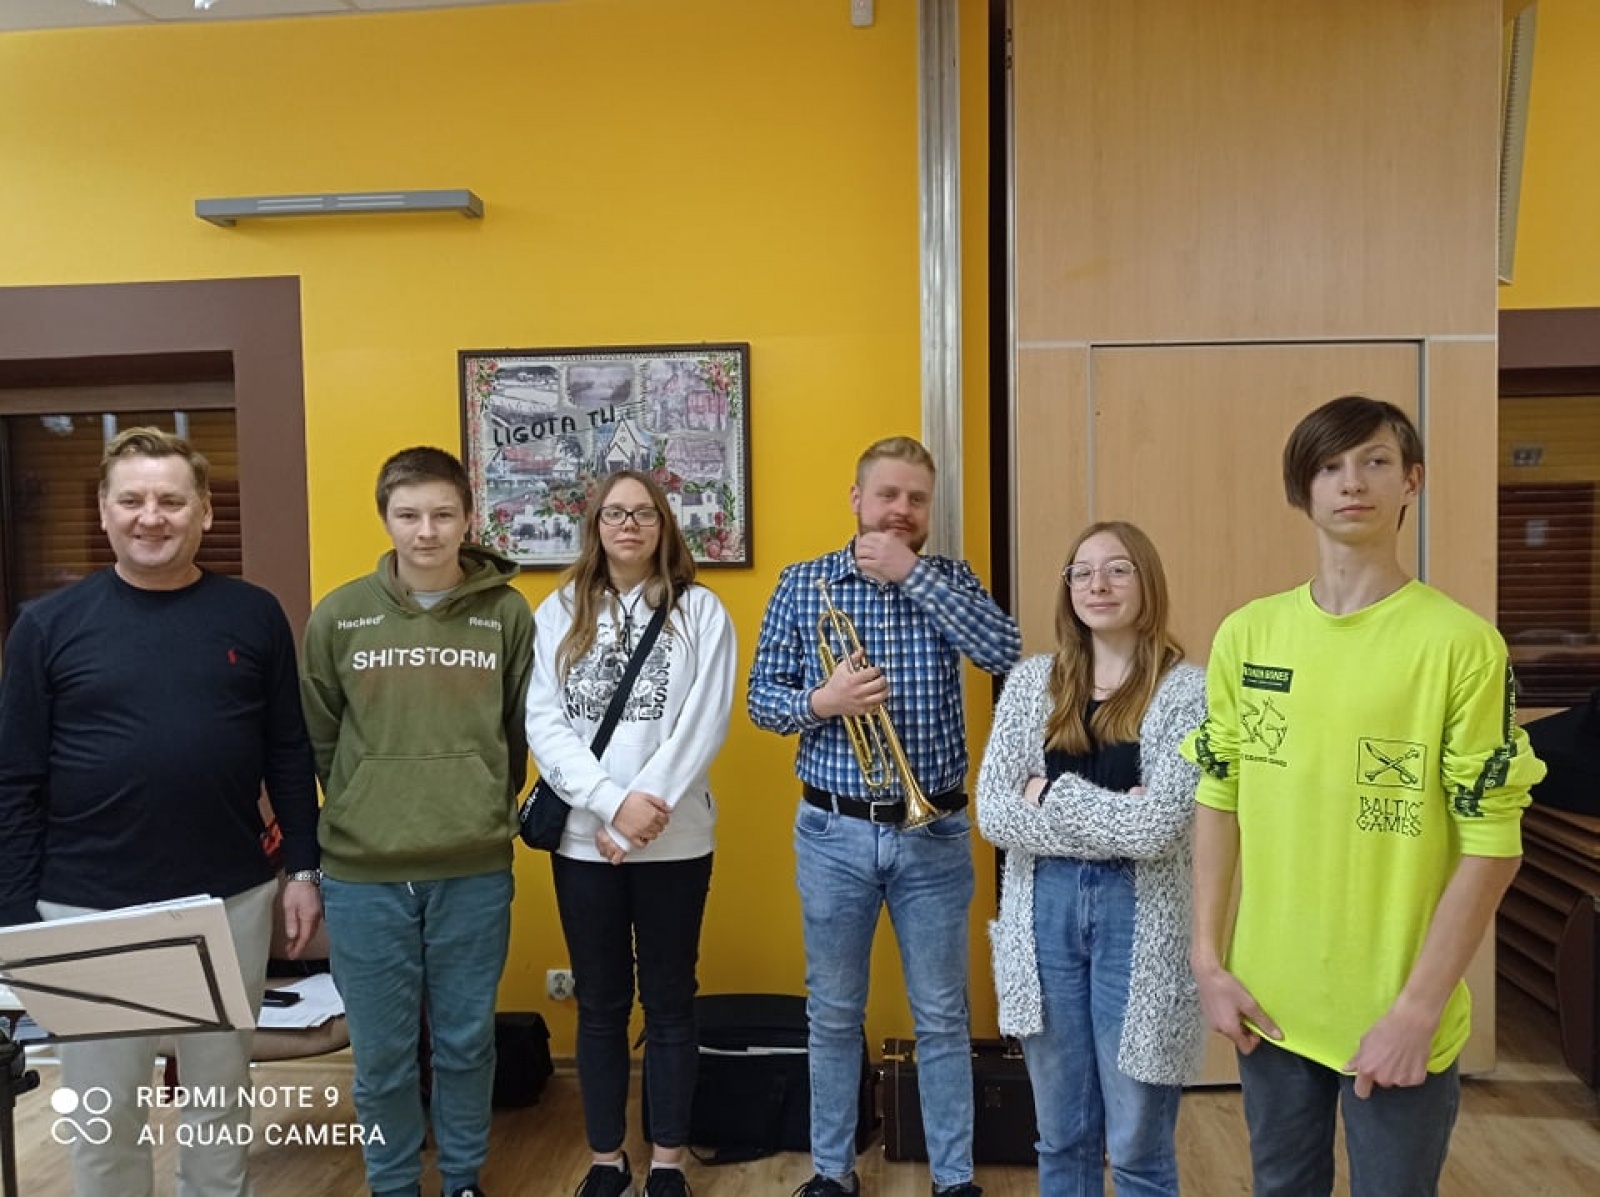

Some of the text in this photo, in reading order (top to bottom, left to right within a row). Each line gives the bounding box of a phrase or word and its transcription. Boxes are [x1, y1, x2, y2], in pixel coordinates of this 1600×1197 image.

[493, 415, 576, 447] LIGOTA
[352, 646, 497, 670] SHITSTORM
[1359, 796, 1421, 820] BALTIC
[1356, 814, 1423, 838] GAMES
